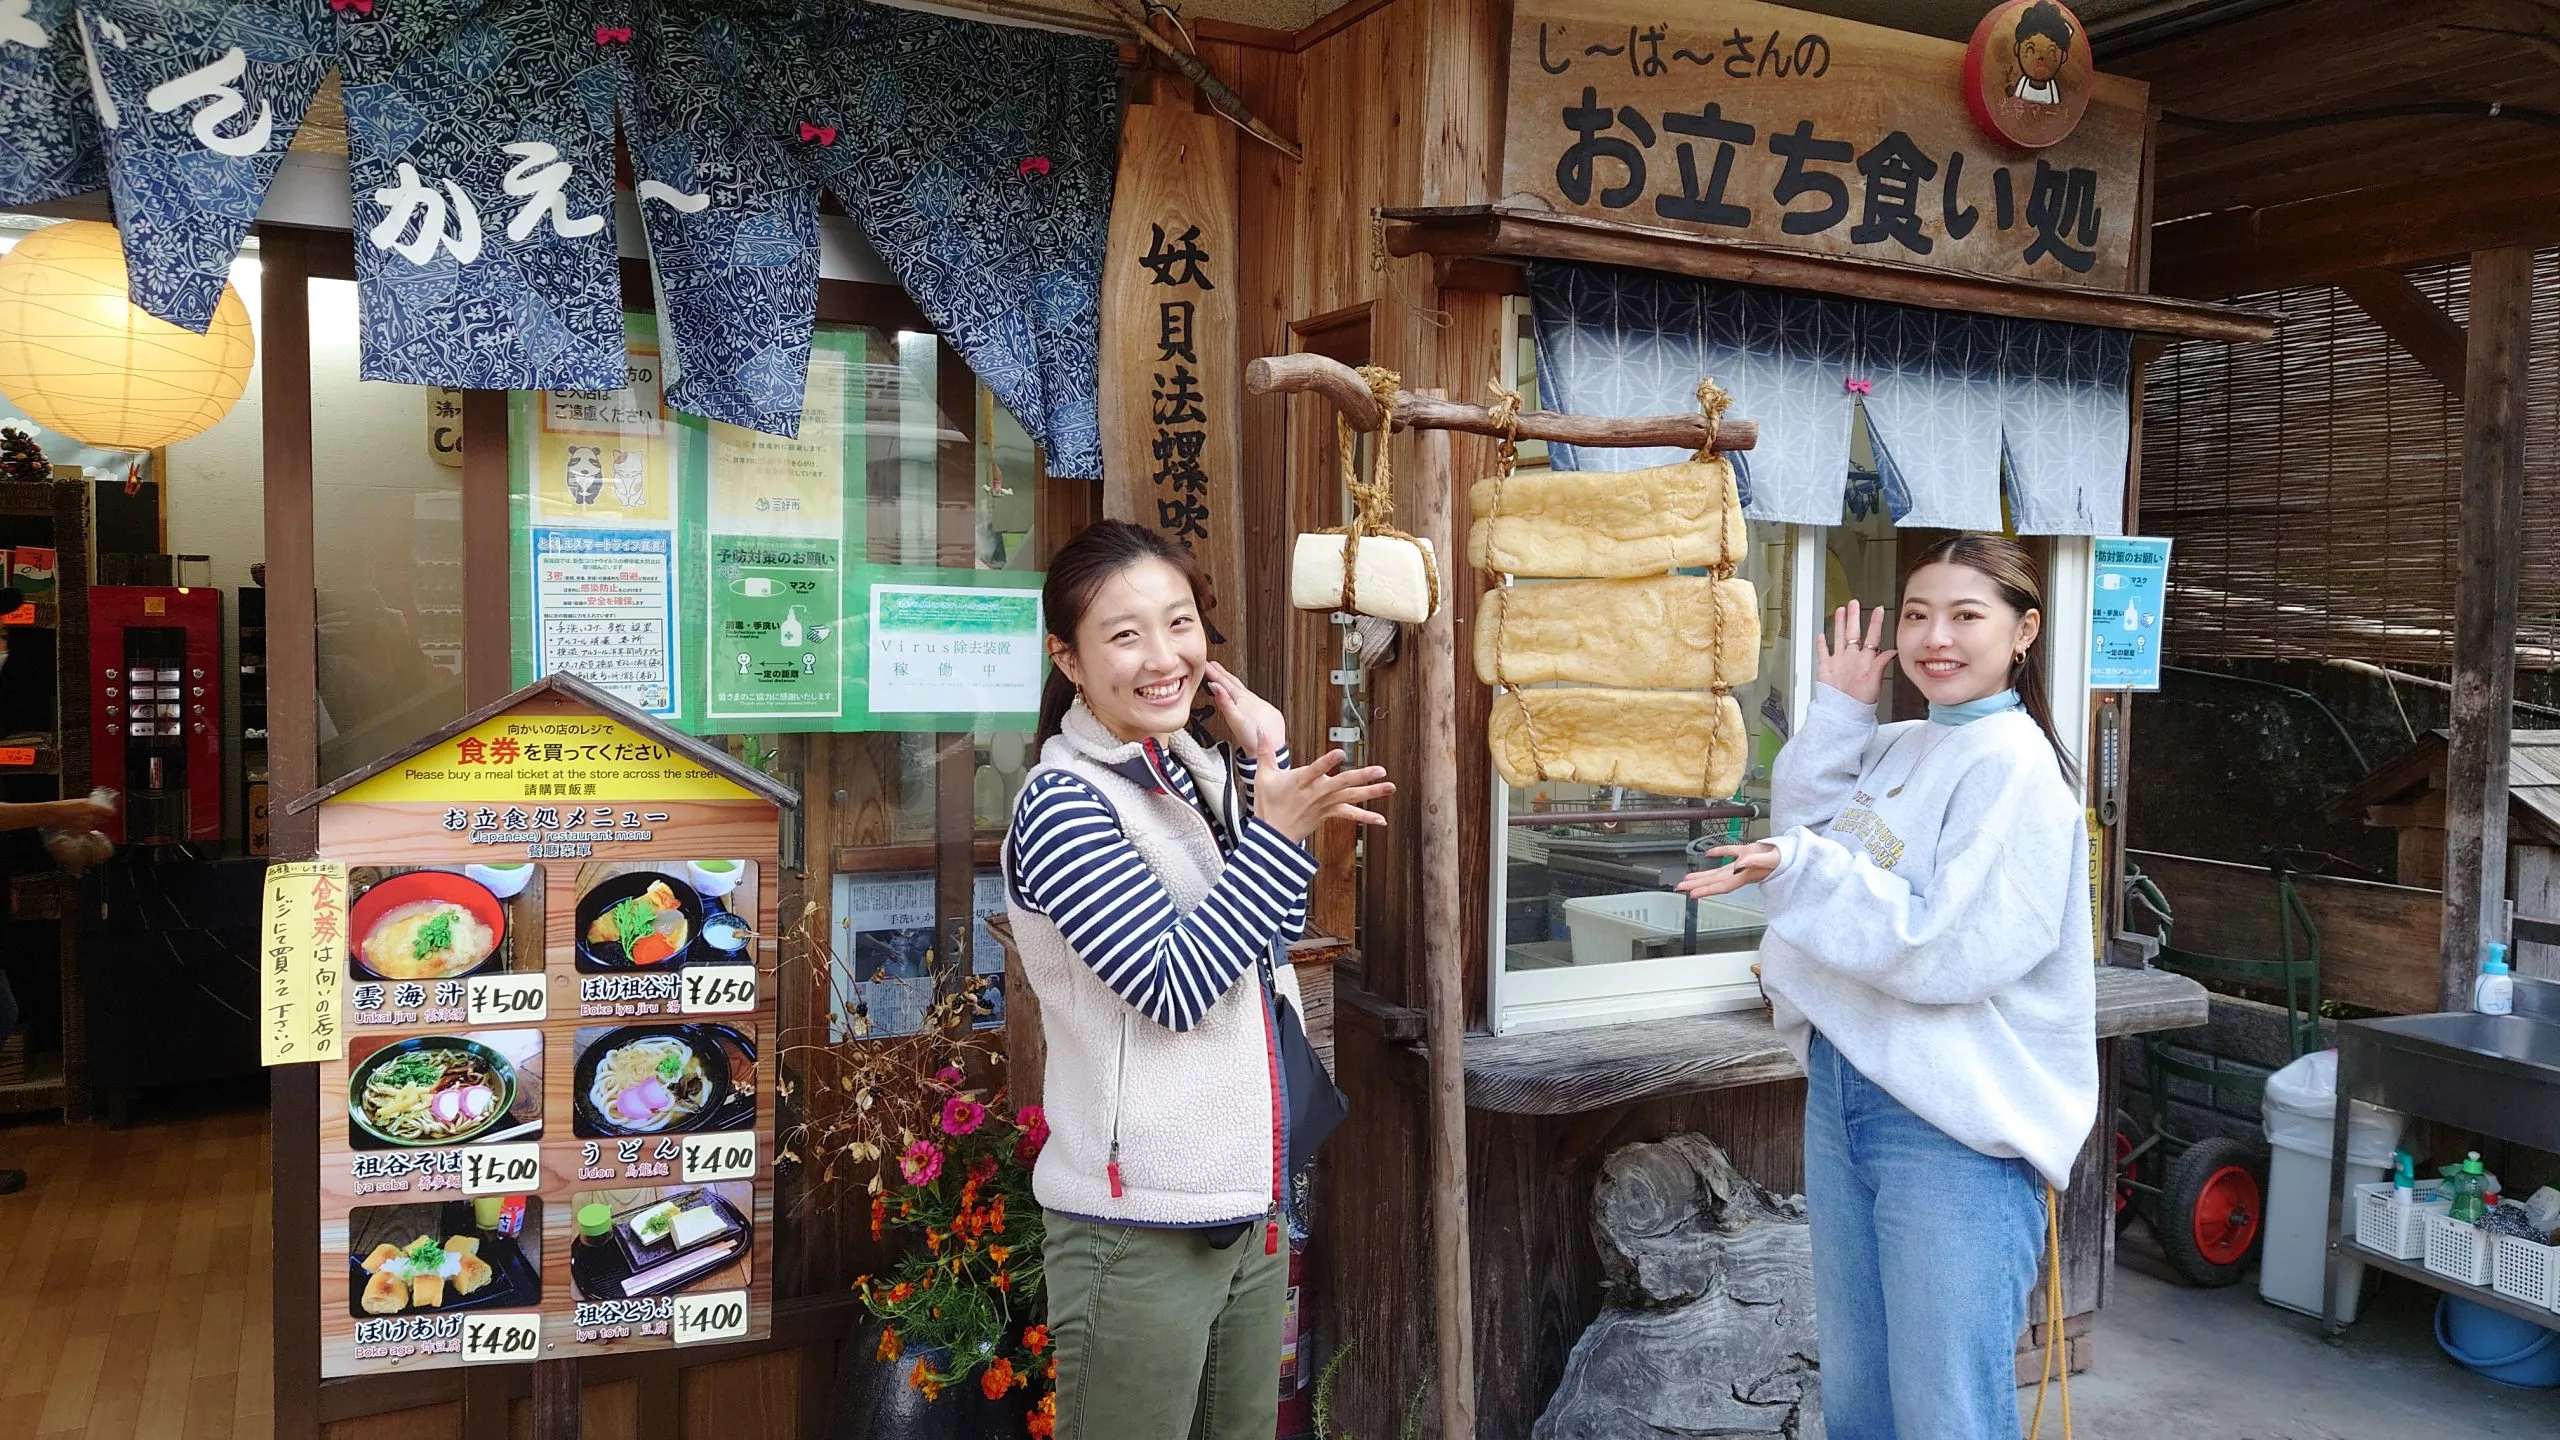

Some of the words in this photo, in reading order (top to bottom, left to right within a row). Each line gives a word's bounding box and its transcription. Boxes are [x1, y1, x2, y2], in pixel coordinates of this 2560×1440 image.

[1555, 86, 2102, 273] お立ち食い処
[555, 404, 652, 424] ご遠慮ください
[717, 549, 835, 566] 予防対策のお願い
[790, 582, 816, 590] マスク
[754, 670, 799, 679] 一定の距離
[508, 724, 614, 735] 向かいの店のレジで
[457, 736, 671, 766] 食券を買ってください
[405, 769, 444, 780] Please
[448, 769, 470, 782] buy
[474, 772, 482, 780] a
[485, 769, 513, 779] meal
[517, 769, 548, 779] ticket
[553, 770, 565, 779] at
[568, 769, 586, 779] the
[590, 770, 619, 779] store
[623, 771, 660, 779] across
[663, 769, 682, 779] the
[685, 769, 718, 779] street
[524, 784, 597, 796] 請購買飯票
[443, 806, 670, 830] お立食処メニュー
[468, 829, 541, 844] (Japanese)
[545, 830, 613, 841] restaurant
[614, 830, 651, 841] menu
[353, 982, 465, 1008] 雲海汁
[581, 974, 681, 1000] ぼけ祖谷汁
[686, 975, 755, 1005] ¥650
[471, 985, 544, 1013] ¥500
[581, 1004, 613, 1016] Boke
[615, 1003, 633, 1015] iya
[636, 1003, 659, 1015] jiru
[354, 1011, 392, 1023] Unkai
[392, 1010, 417, 1024] jiru
[580, 1138, 680, 1165] うどん
[685, 1145, 753, 1174] ¥400
[352, 1150, 463, 1177] 祖谷そば
[468, 1154, 537, 1187] ¥500
[579, 1167, 615, 1180] Udon
[354, 1181, 374, 1194] Iya
[376, 1179, 409, 1191] soba
[573, 1297, 675, 1326] 祖谷とうふ
[679, 1303, 743, 1333] ¥400
[355, 1313, 464, 1343] ぼけあげ
[468, 1323, 537, 1354] ¥480
[576, 1329, 597, 1341] Iya
[600, 1325, 629, 1338] tofu
[639, 1321, 669, 1336] 豆腐
[355, 1346, 388, 1359] Boke
[389, 1344, 414, 1357] age
